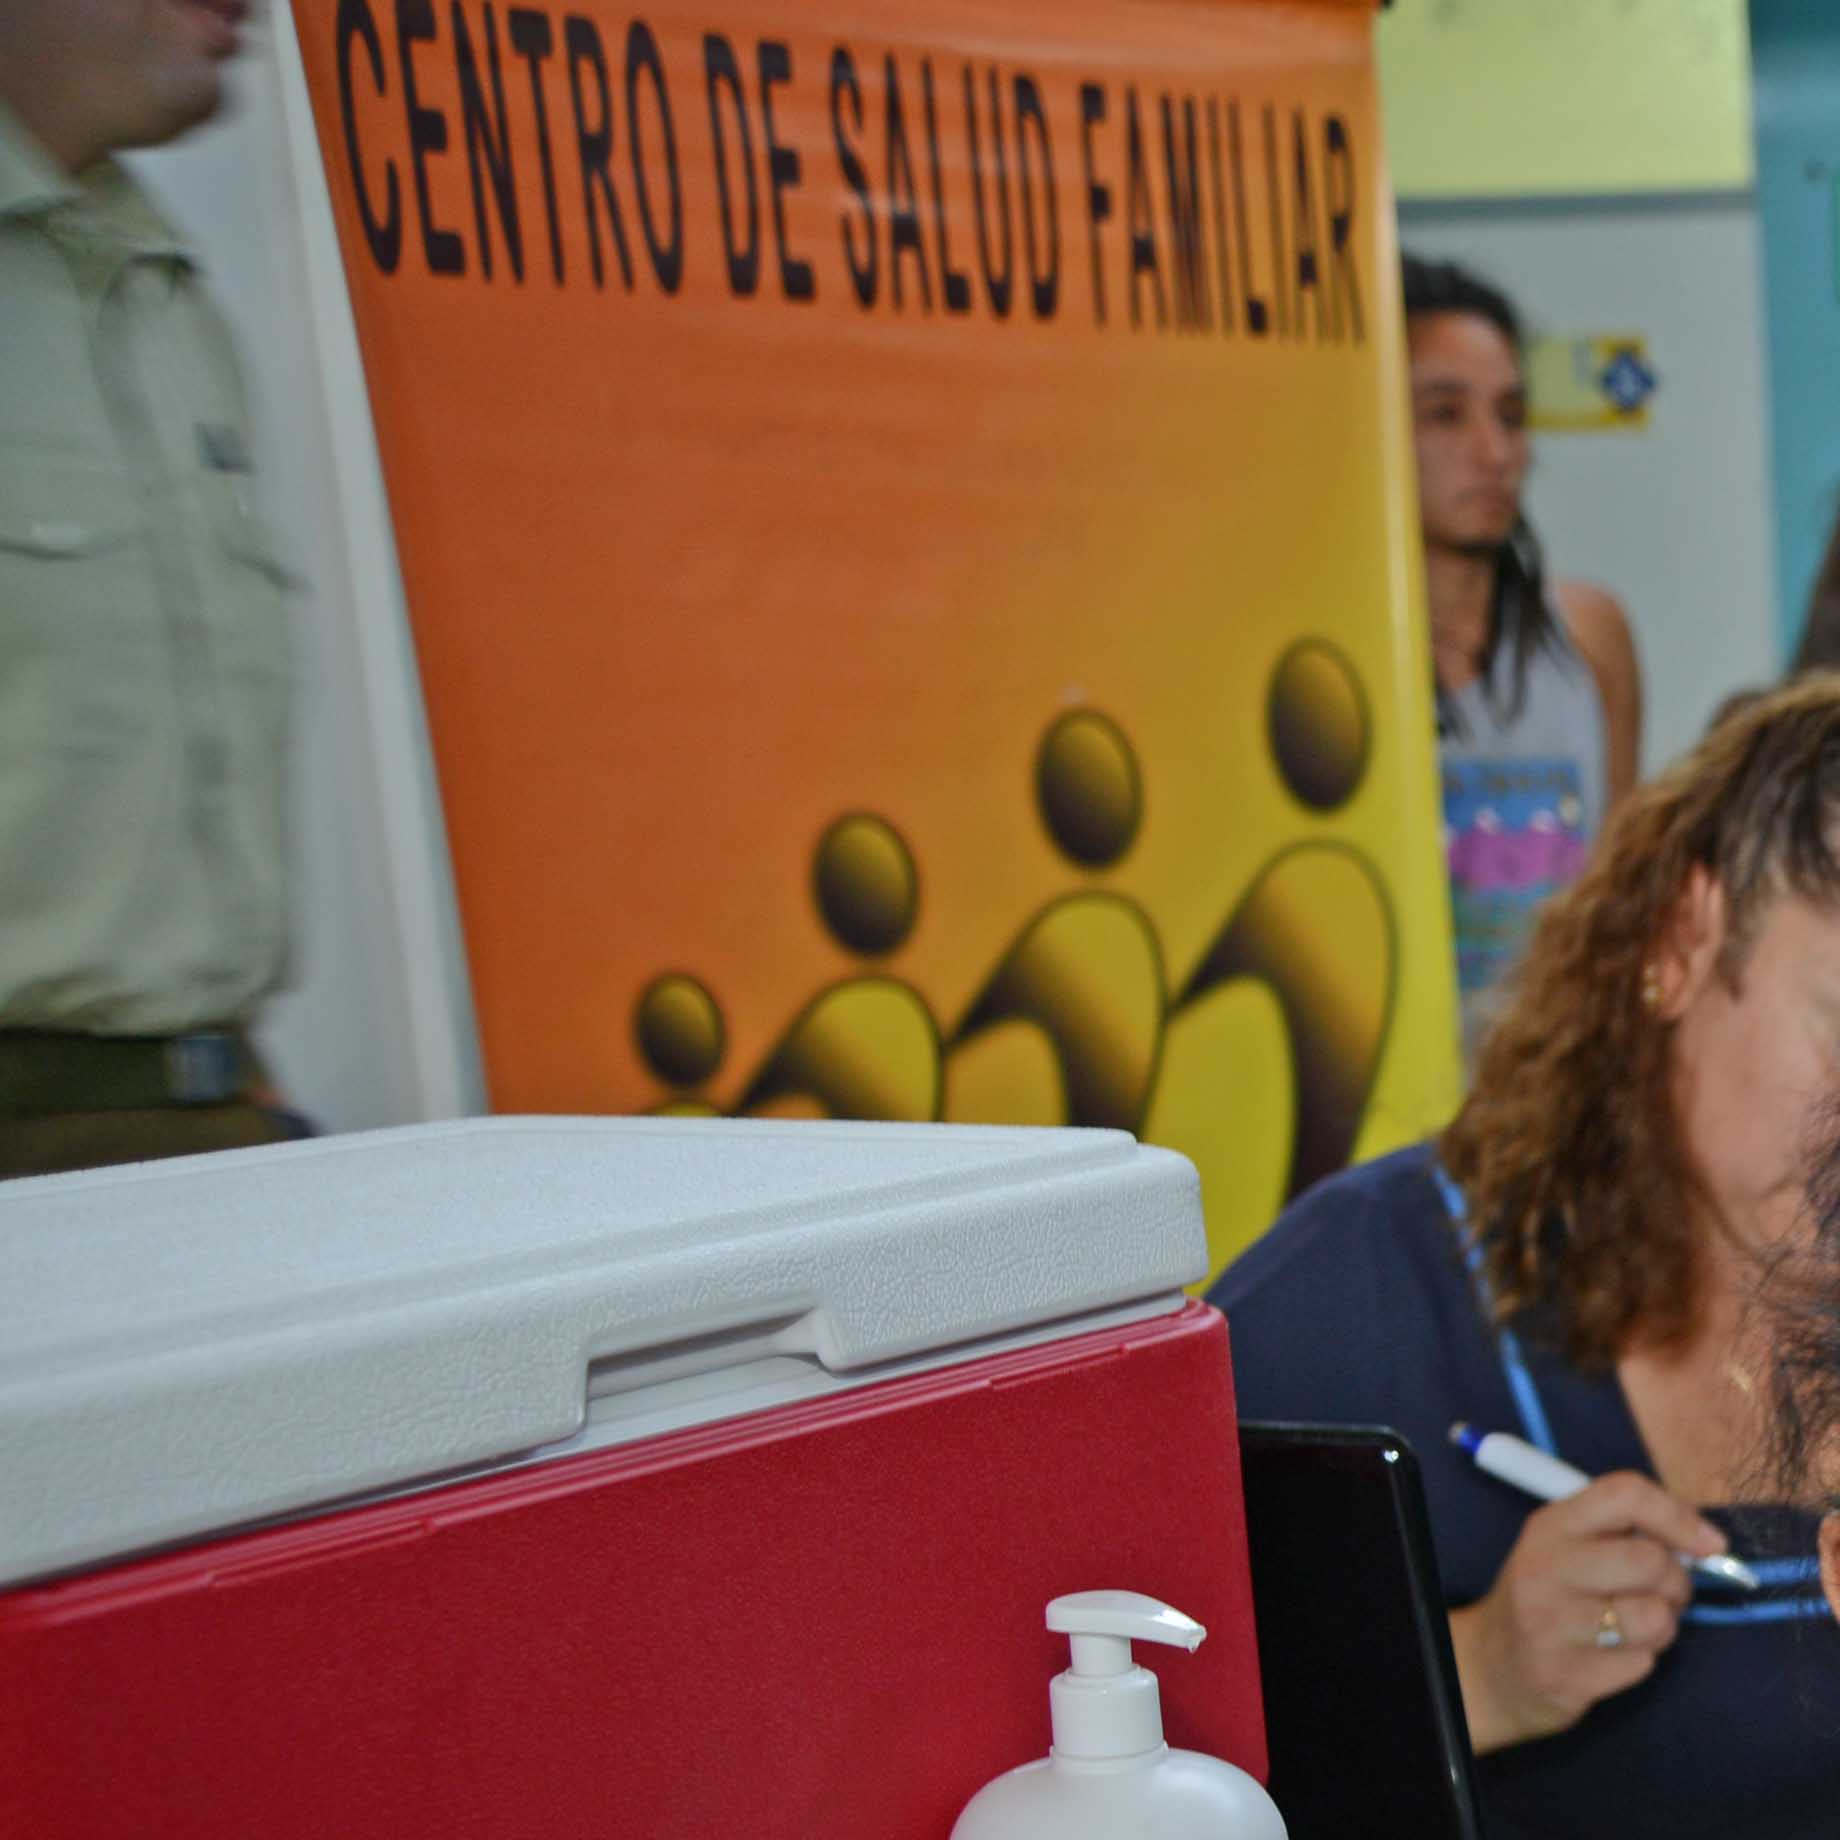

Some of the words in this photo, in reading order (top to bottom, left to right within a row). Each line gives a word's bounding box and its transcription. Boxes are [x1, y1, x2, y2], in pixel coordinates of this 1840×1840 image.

[335, 0, 684, 294] CENTRO
[703, 32, 816, 302] DE
[829, 44, 1060, 319] SALUD
[1079, 80, 1366, 350] FAMILIAR
